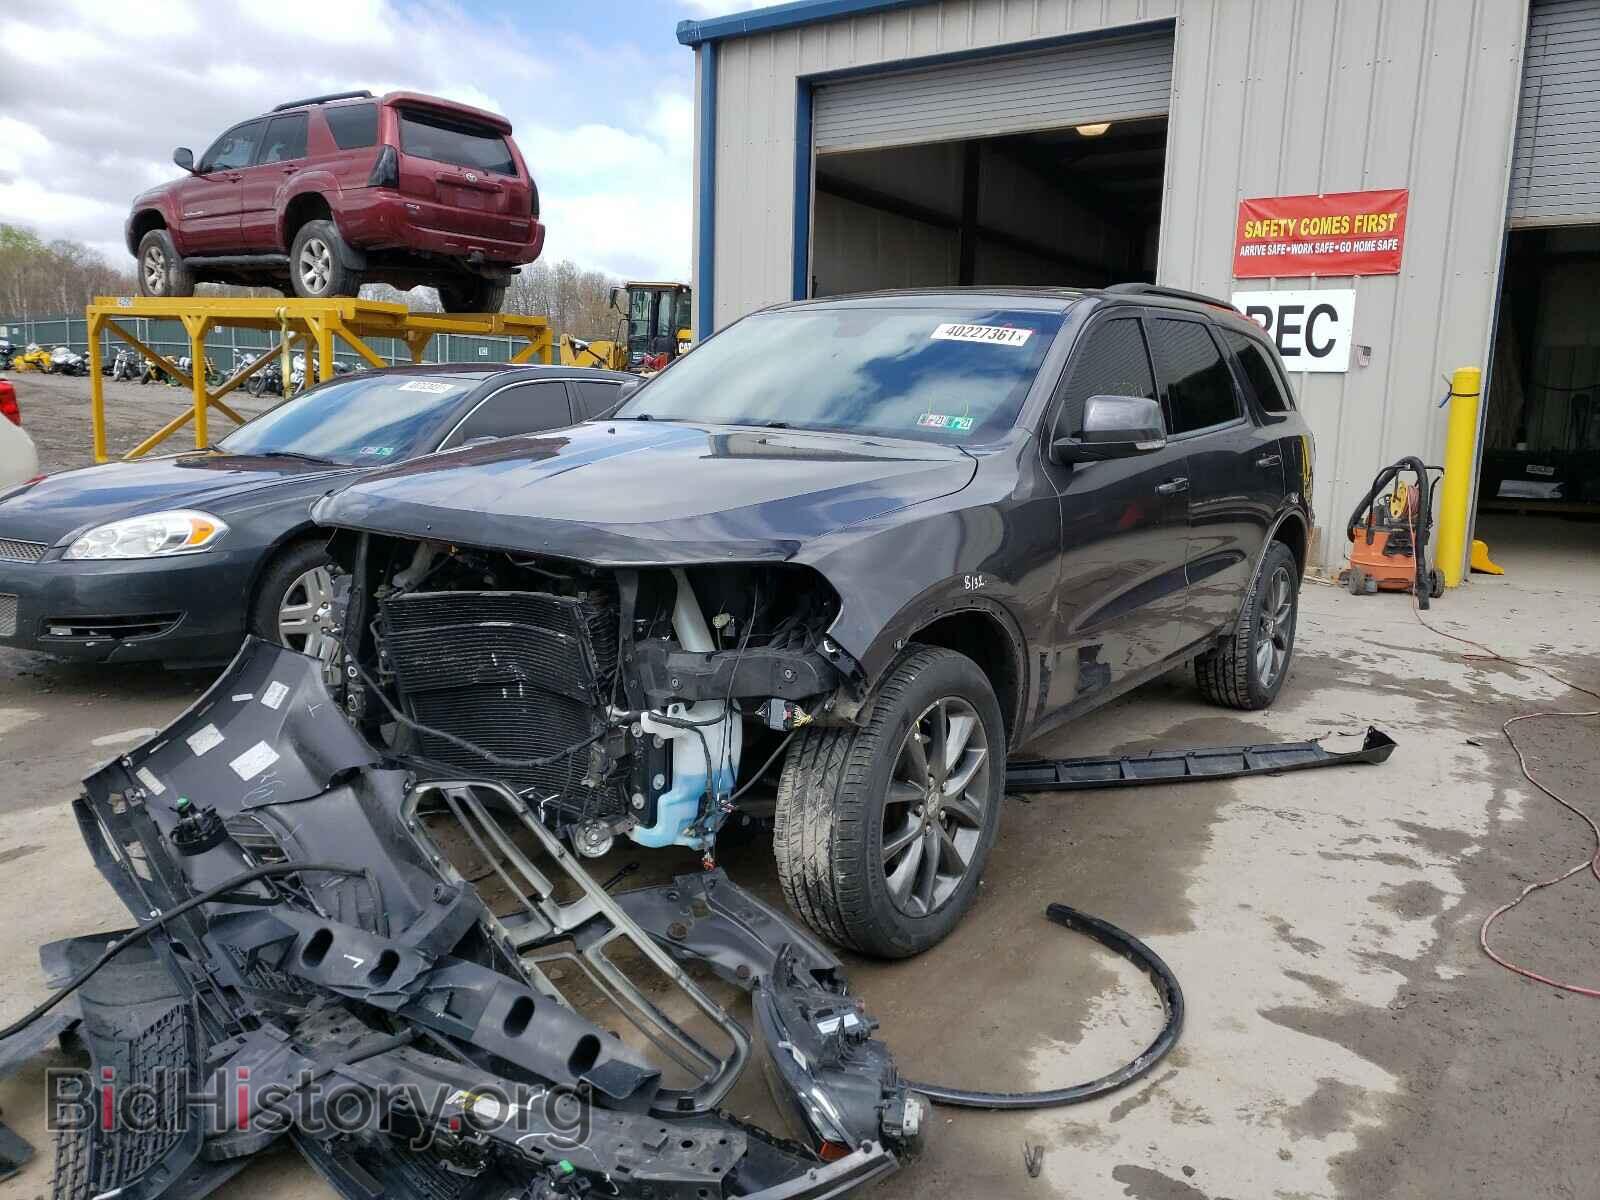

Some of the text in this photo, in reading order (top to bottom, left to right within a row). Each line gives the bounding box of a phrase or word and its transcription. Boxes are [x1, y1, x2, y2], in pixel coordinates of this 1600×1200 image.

[1245, 213, 1398, 239] SAFETY COMES FIRST
[1240, 238, 1399, 257] ARRIVE SAFE WORK SAFE GO HOME SAFE
[945, 325, 1017, 342] 40227361
